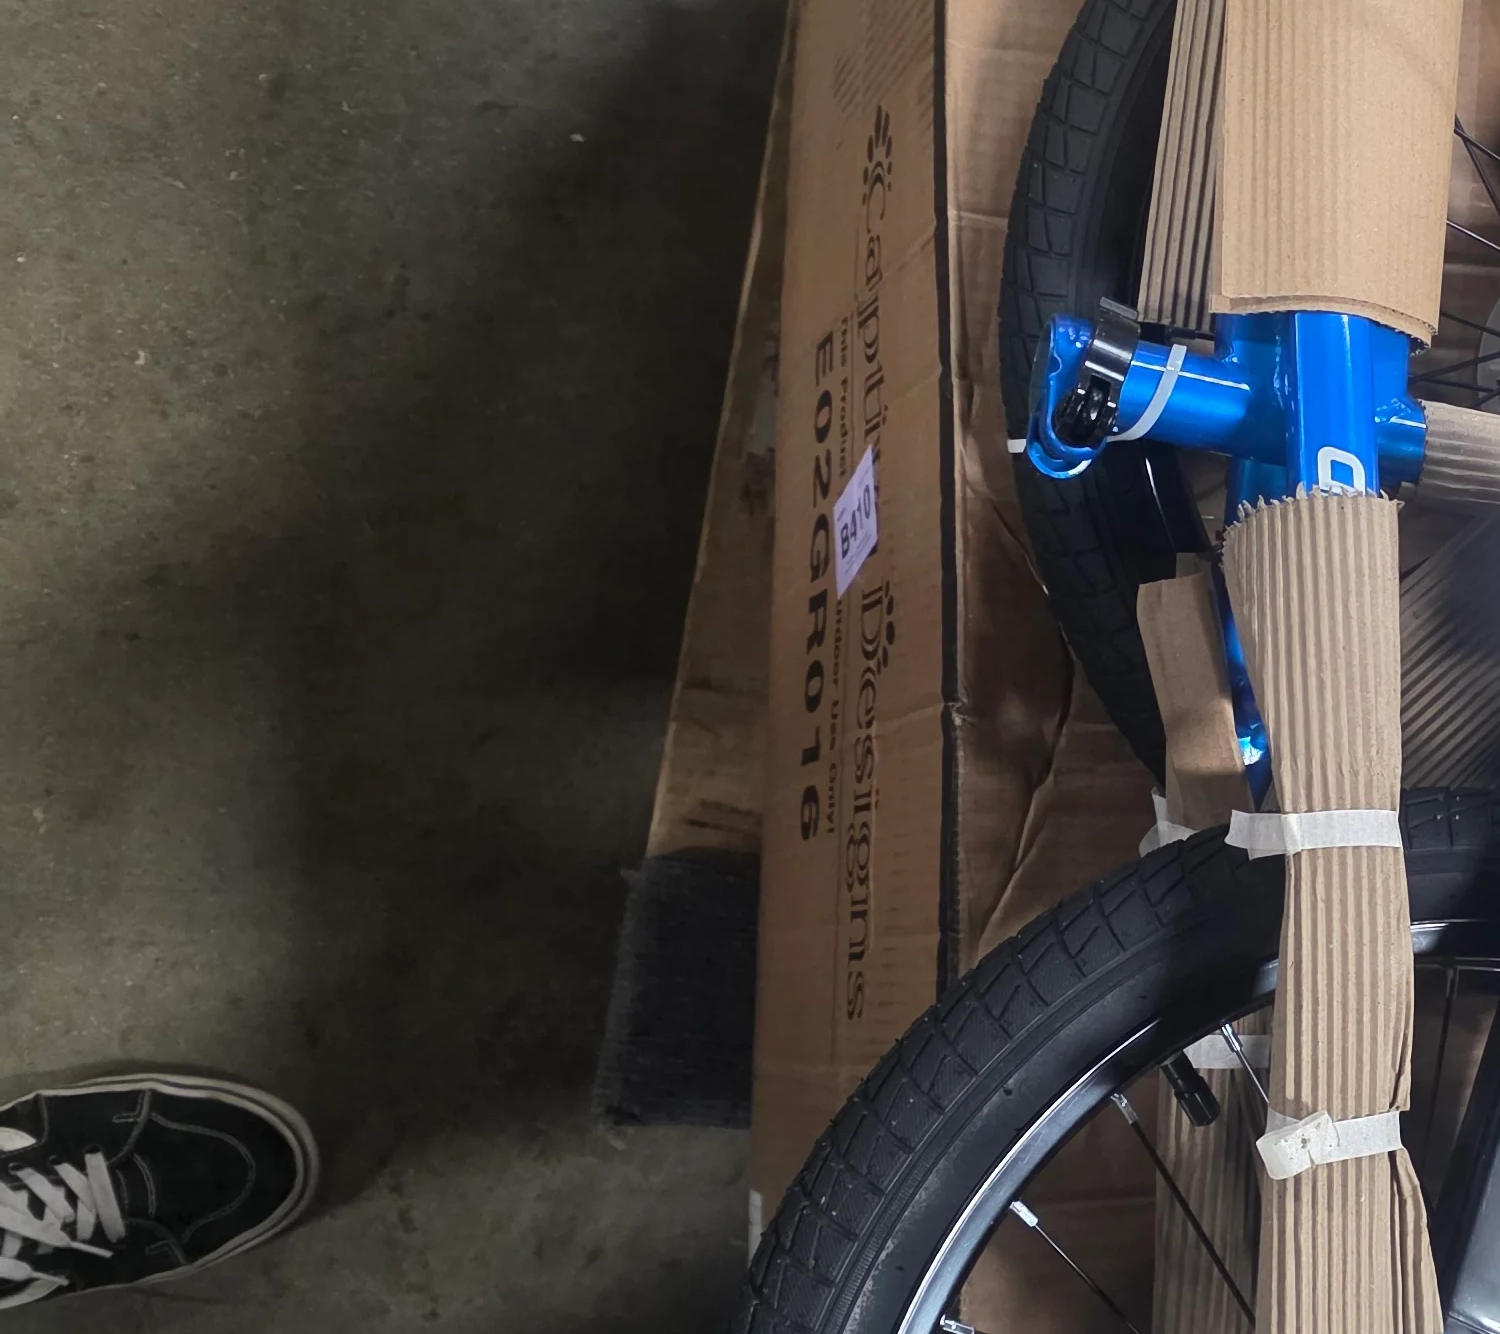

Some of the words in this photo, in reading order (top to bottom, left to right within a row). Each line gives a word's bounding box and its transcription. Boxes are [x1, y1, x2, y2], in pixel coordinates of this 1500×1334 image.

[857, 163, 888, 556] Capti
[838, 376, 849, 478] Product
[840, 484, 872, 560] B410
[800, 330, 834, 842] E02GR016
[829, 699, 840, 752] Use
[826, 762, 838, 834] Only!
[847, 577, 884, 1020] Designs
